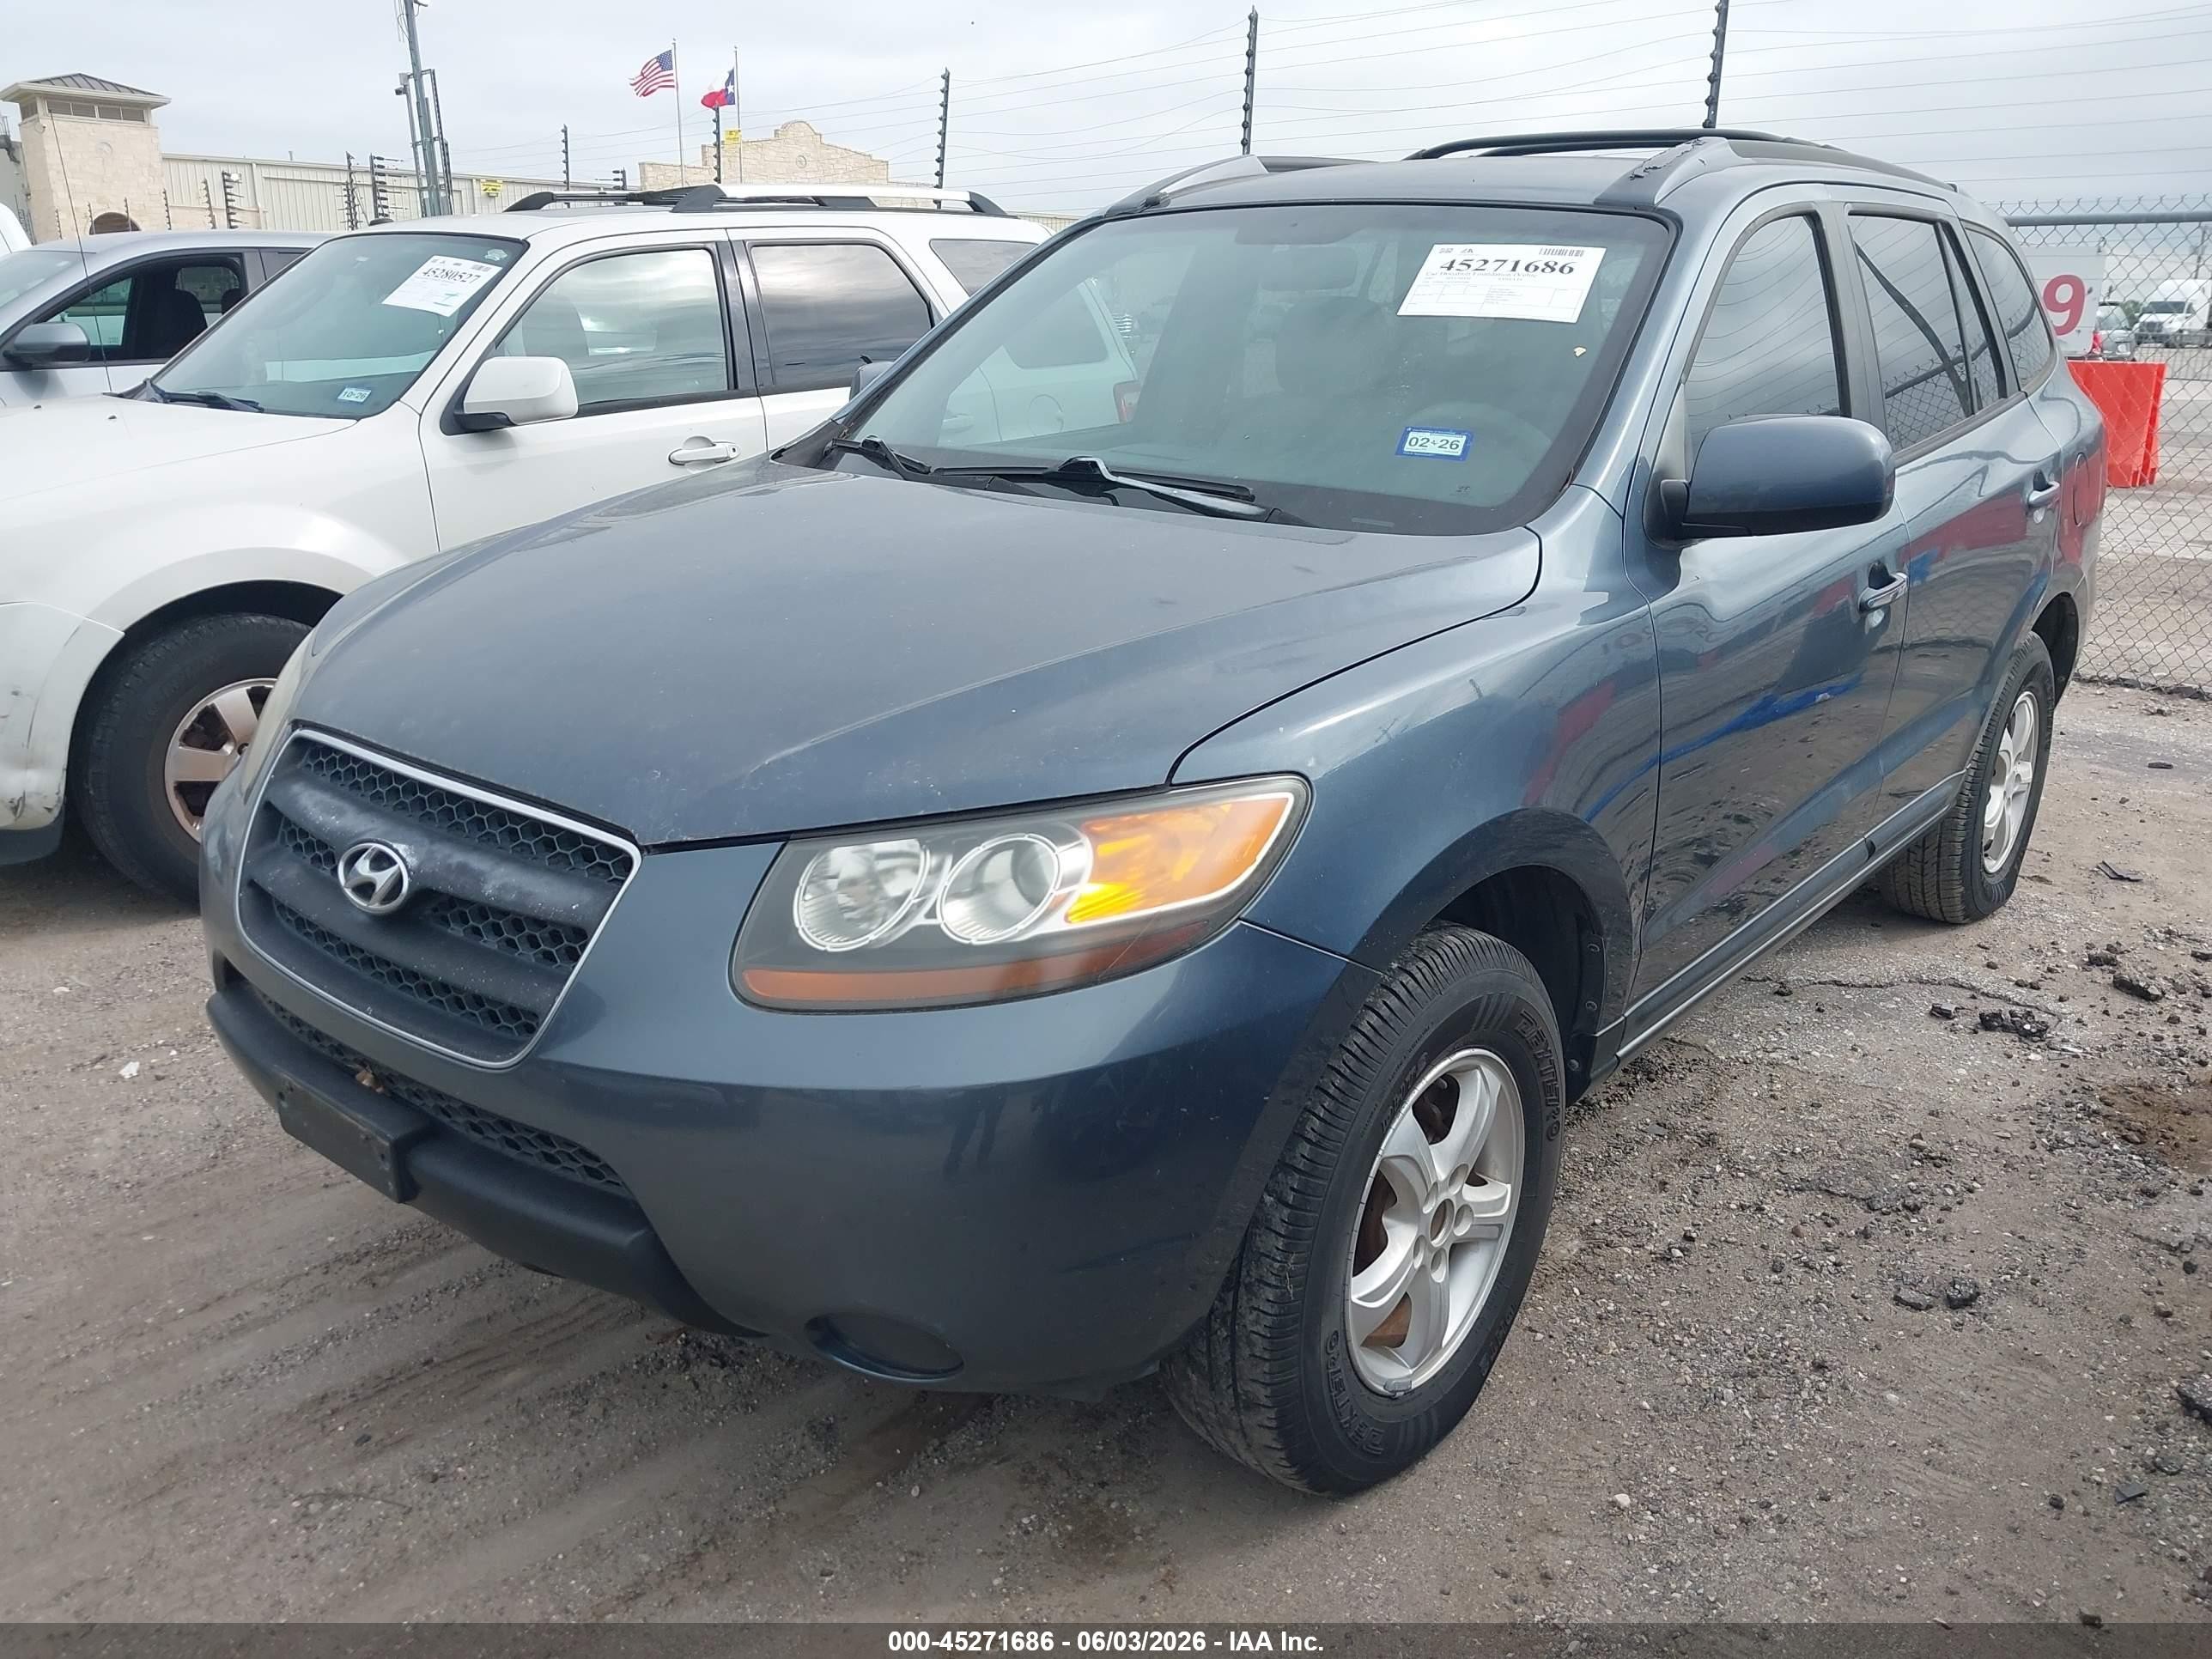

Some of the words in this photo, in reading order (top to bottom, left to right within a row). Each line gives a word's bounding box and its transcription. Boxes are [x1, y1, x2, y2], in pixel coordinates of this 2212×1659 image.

[422, 267, 481, 283] 45280527
[1440, 258, 1575, 275] 45271686
[2042, 274, 2086, 336] 9
